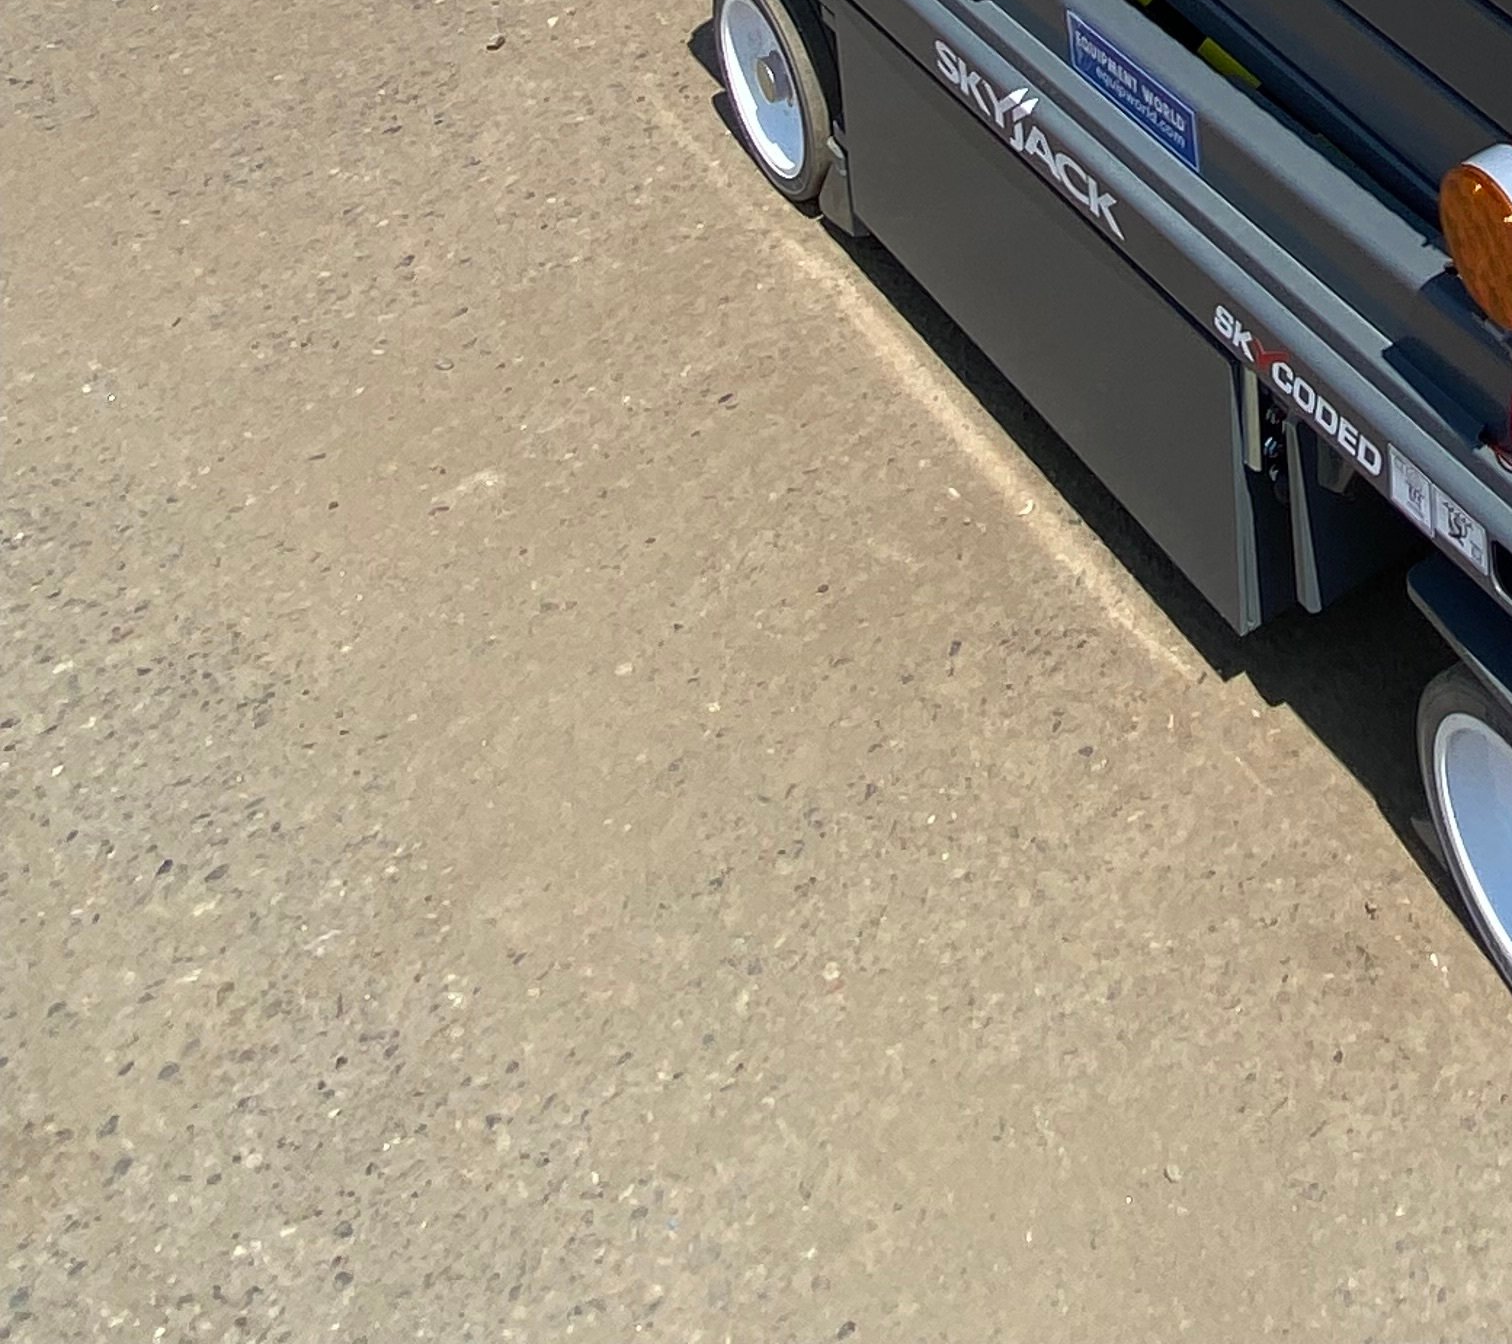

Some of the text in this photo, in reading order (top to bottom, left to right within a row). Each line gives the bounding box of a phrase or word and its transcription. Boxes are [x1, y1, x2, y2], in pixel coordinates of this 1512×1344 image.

[934, 39, 1124, 240] SKYJACK
[1075, 30, 1186, 132] EQUIPMENT WORLD
[1213, 305, 1383, 476] SKYCODED
